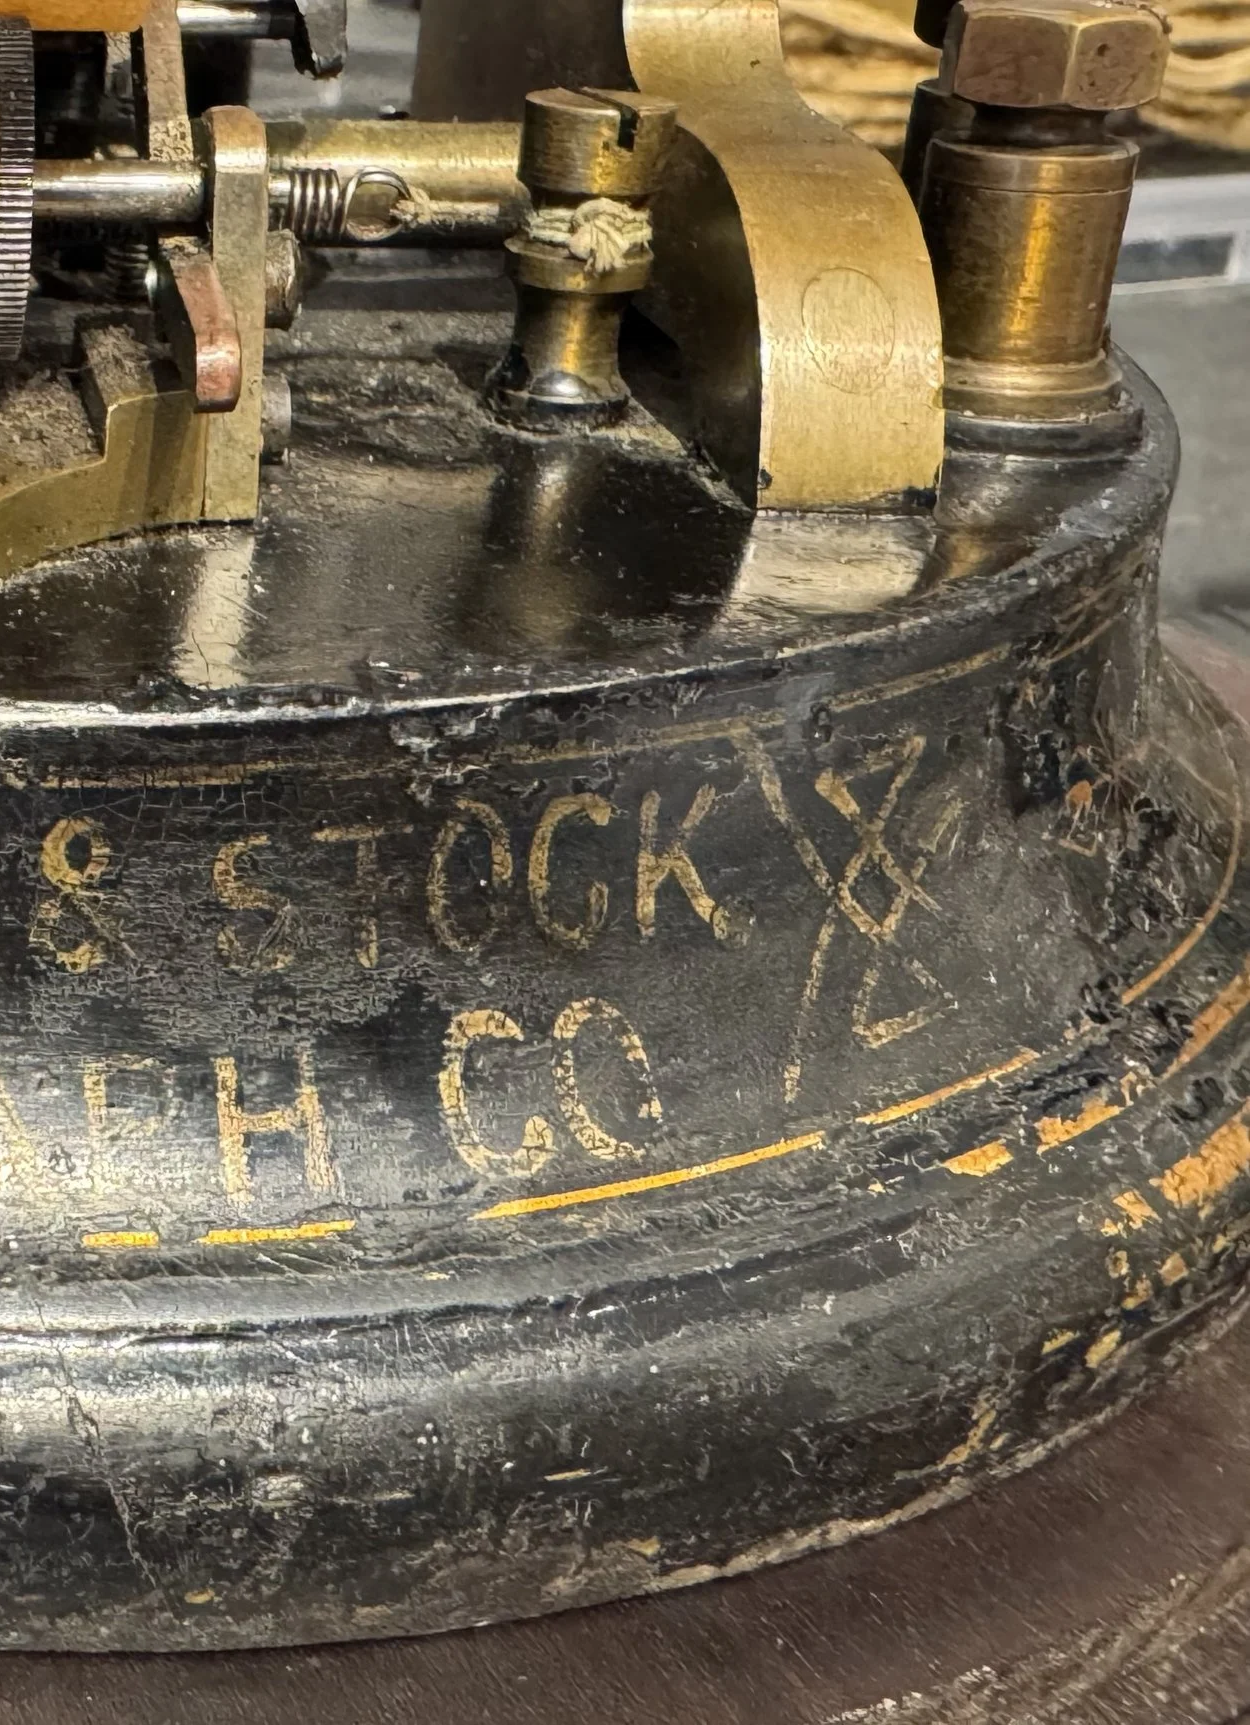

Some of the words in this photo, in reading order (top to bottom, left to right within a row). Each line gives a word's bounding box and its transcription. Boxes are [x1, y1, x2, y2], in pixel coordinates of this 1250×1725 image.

[29, 816, 134, 973] &
[213, 783, 733, 972] STOCK
[437, 996, 664, 1178] CO
